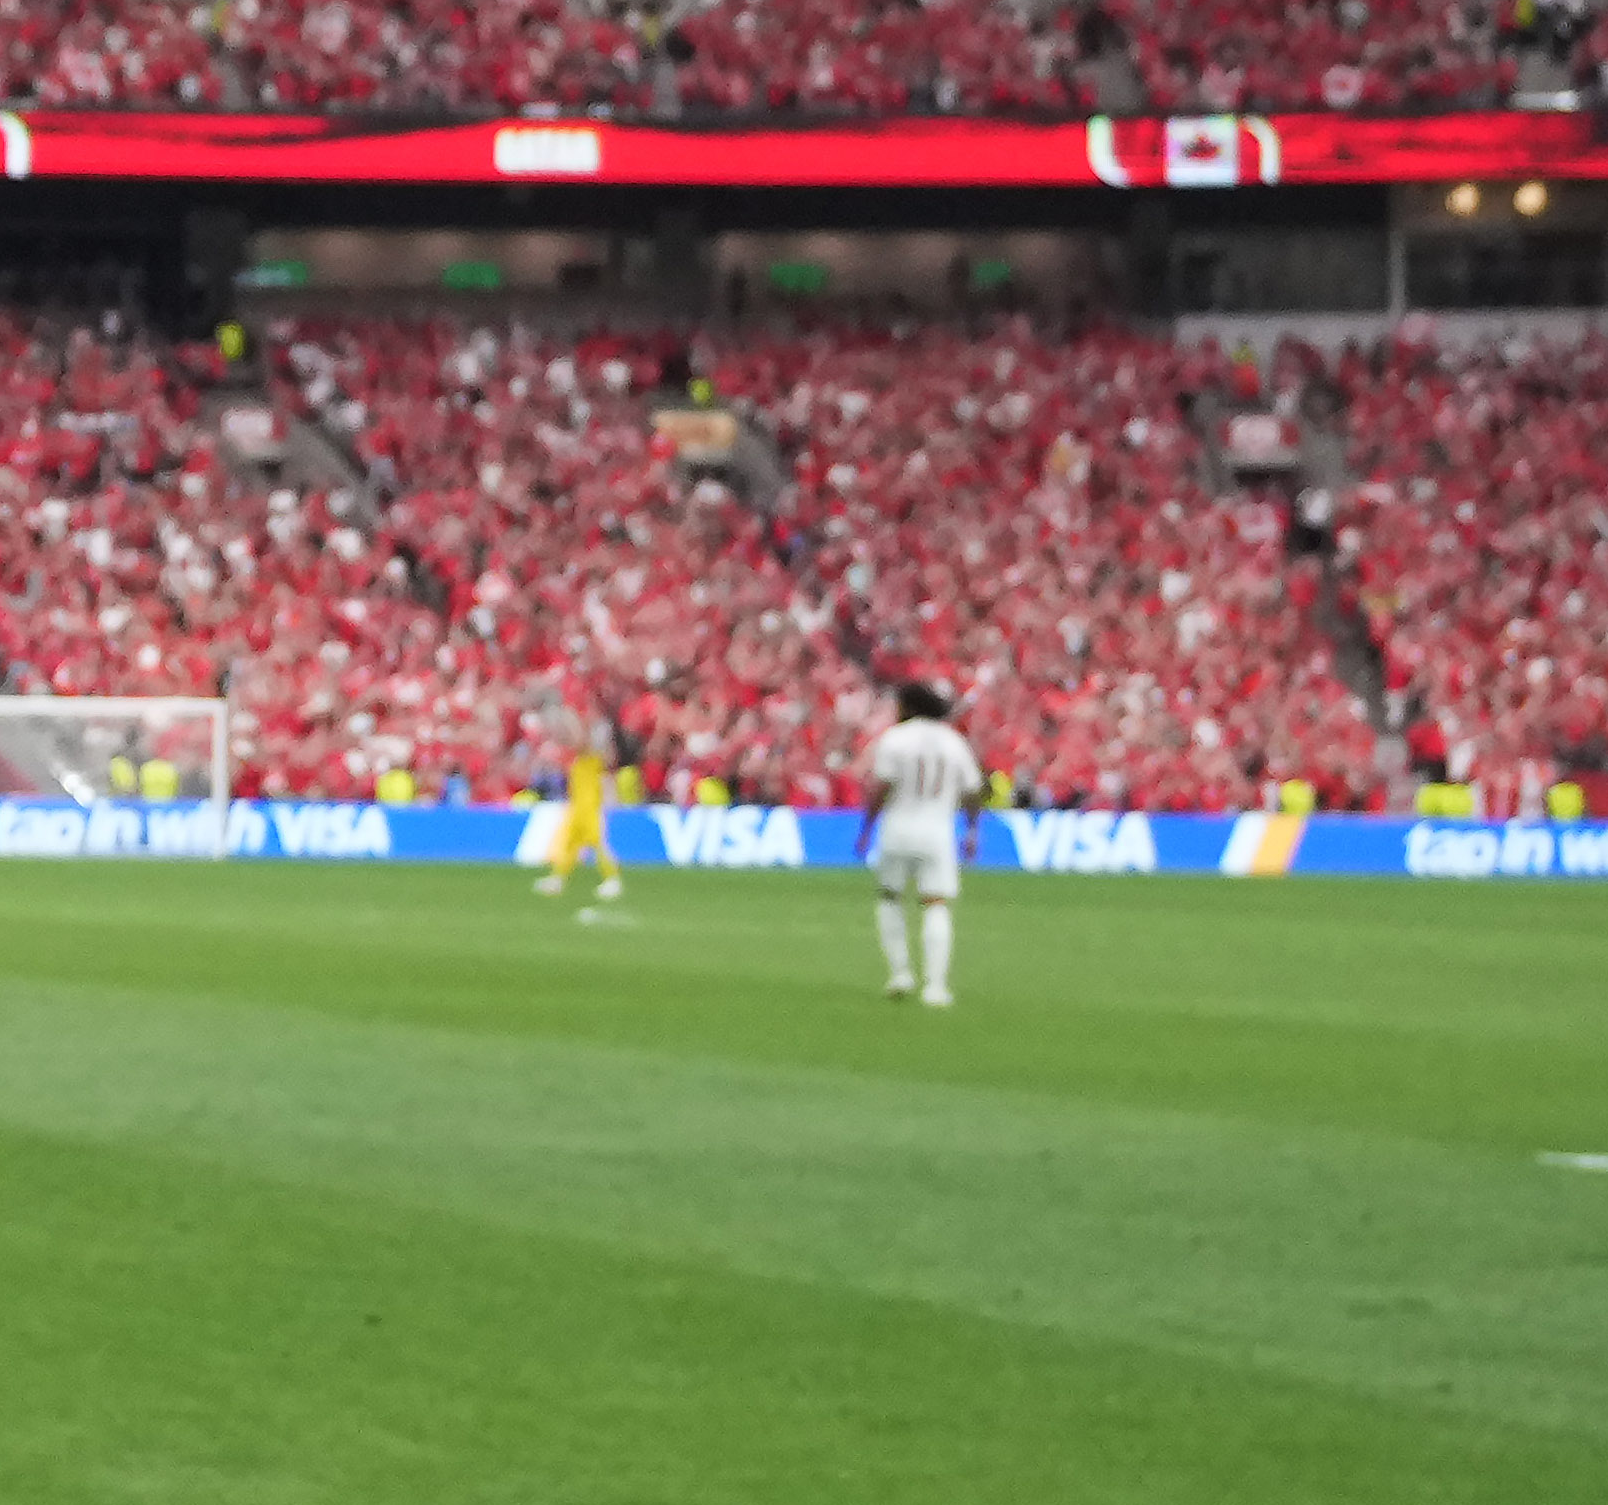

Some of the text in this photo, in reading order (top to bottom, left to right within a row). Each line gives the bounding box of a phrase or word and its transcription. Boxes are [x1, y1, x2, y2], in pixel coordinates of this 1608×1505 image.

[274, 802, 391, 857] VISA
[646, 804, 806, 868] VISA
[994, 809, 1158, 874] VISA
